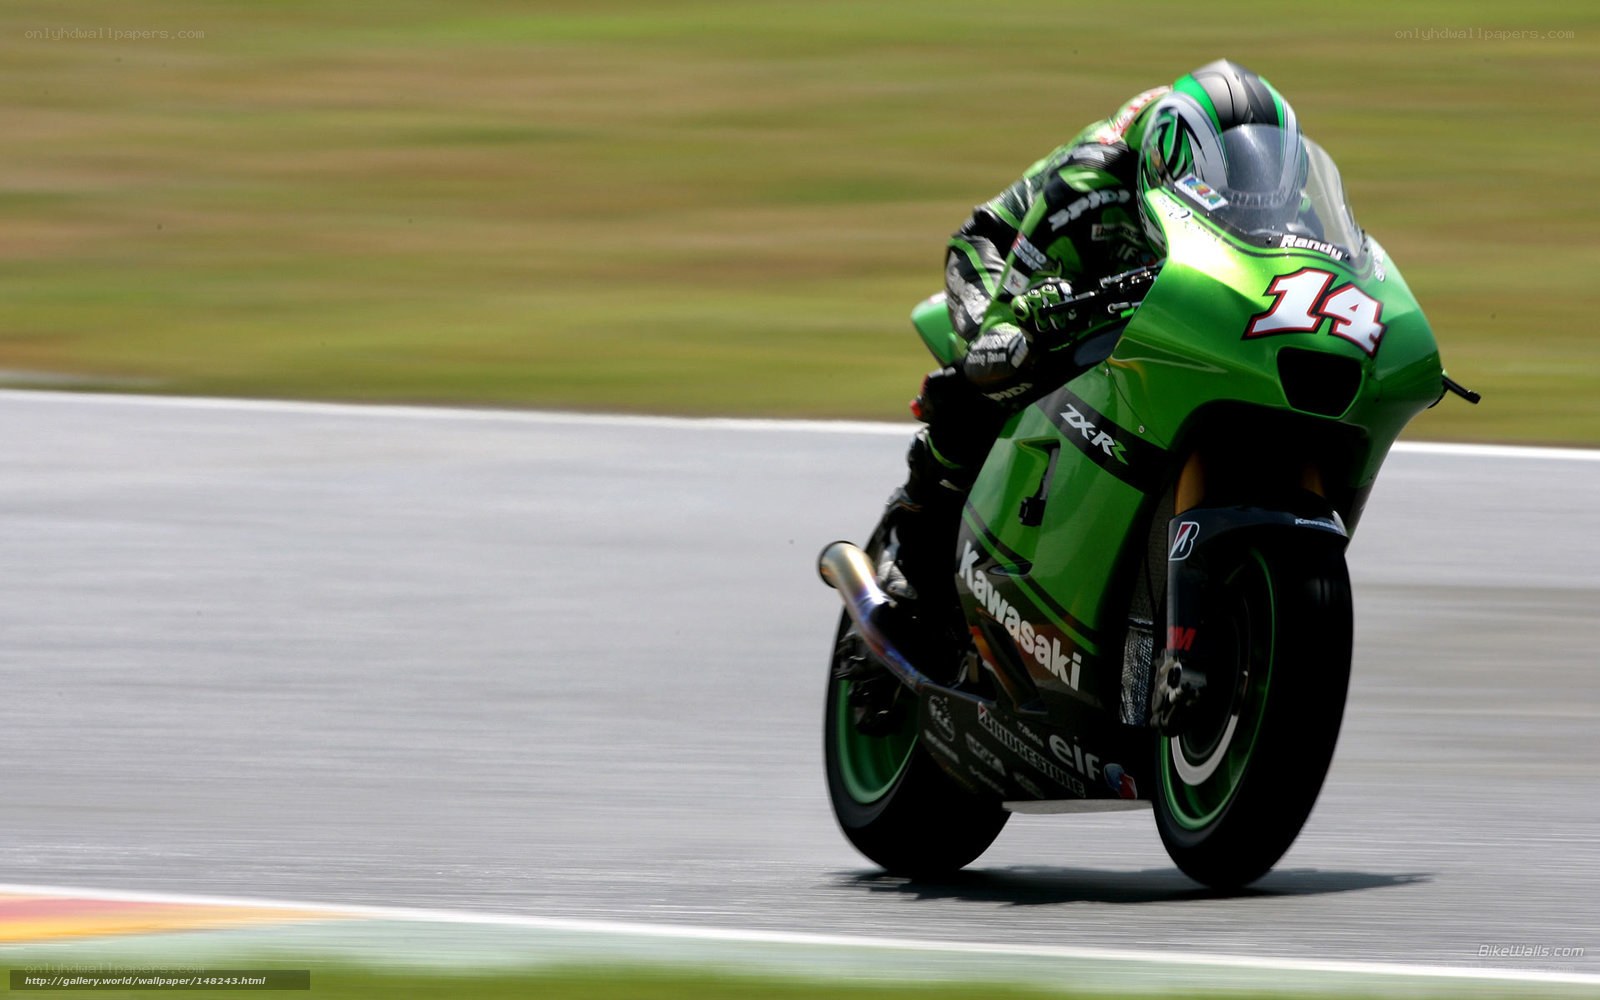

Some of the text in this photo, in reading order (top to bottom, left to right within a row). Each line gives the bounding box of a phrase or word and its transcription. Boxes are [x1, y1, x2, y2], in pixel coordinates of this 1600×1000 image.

[1280, 233, 1343, 261] Randy
[1241, 266, 1388, 358] 14
[958, 540, 1082, 692] Kawasaki
[1049, 733, 1101, 782] elf
